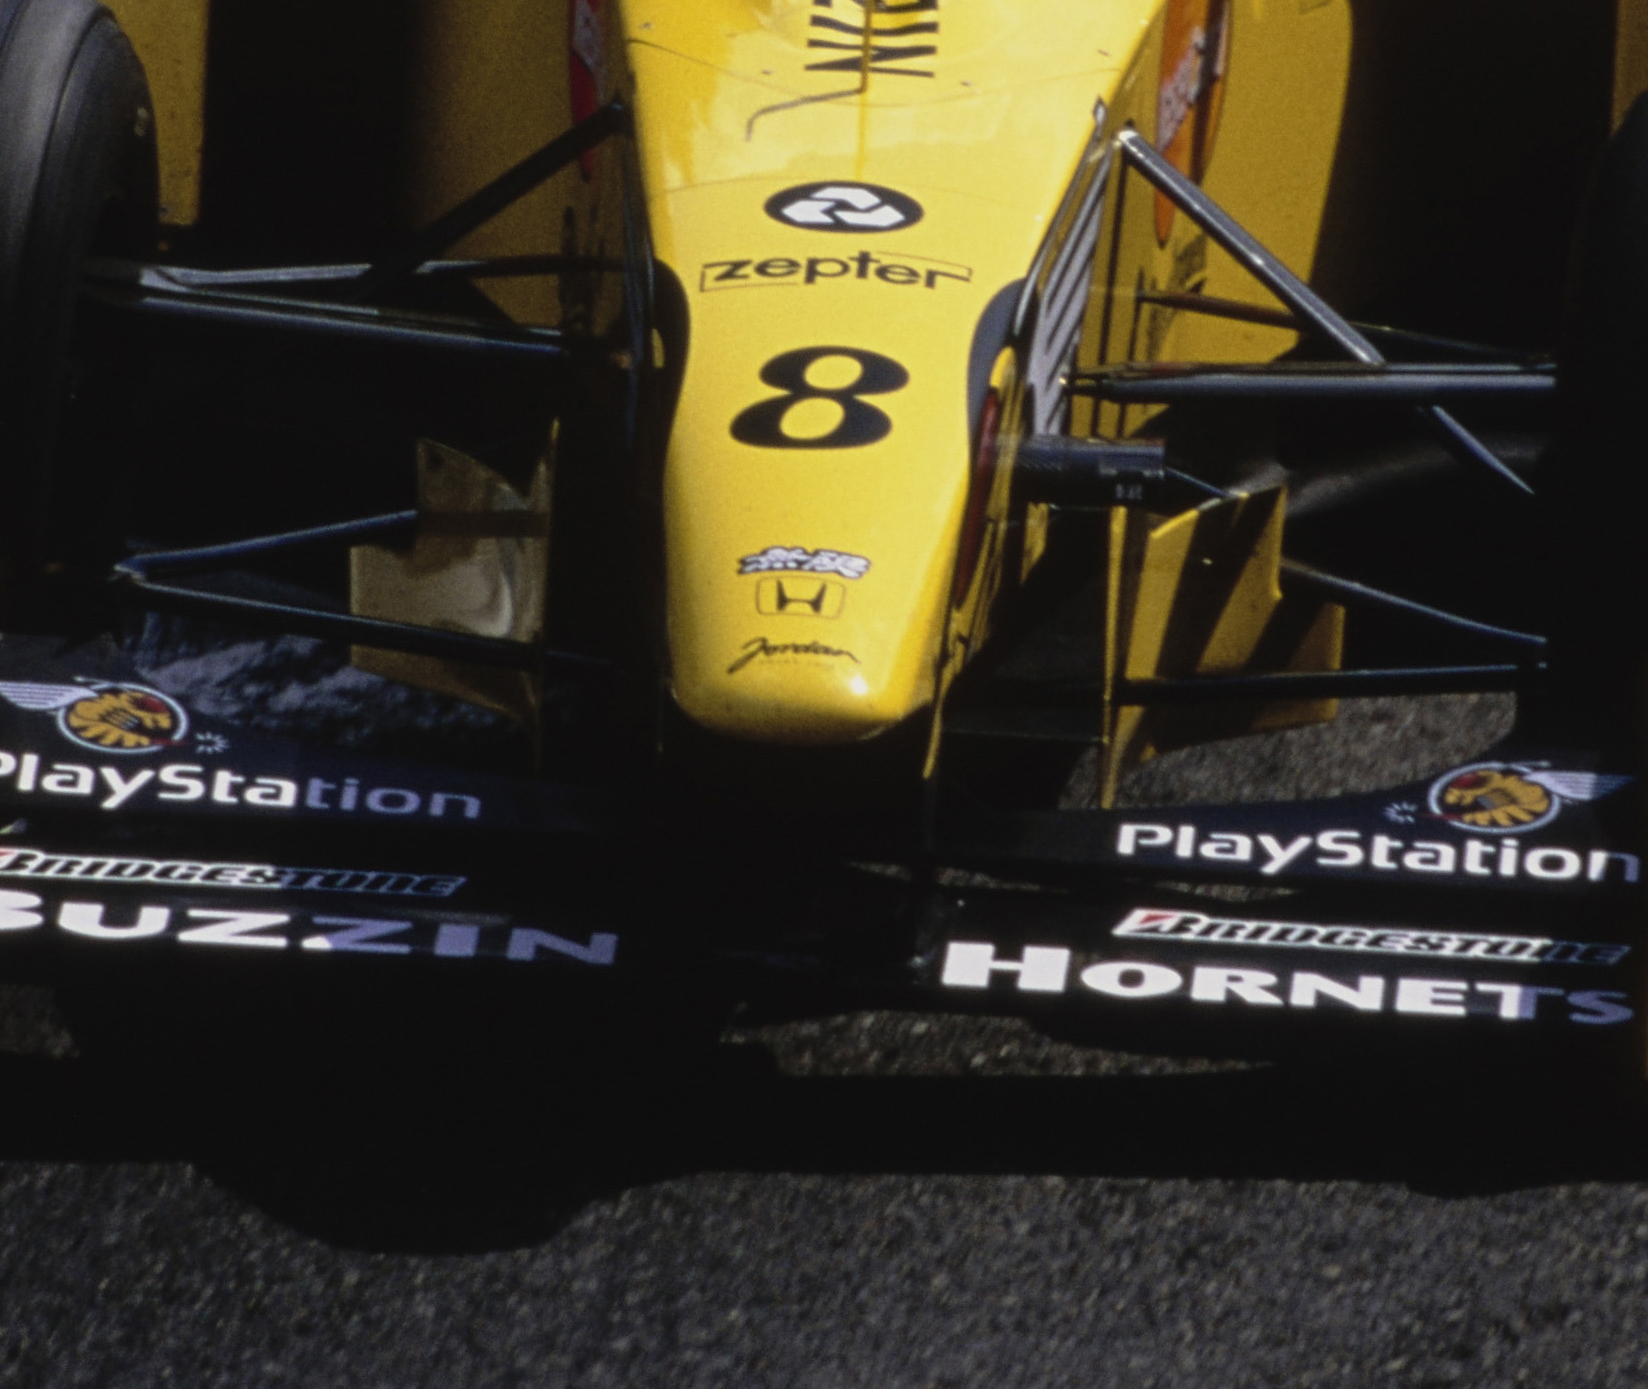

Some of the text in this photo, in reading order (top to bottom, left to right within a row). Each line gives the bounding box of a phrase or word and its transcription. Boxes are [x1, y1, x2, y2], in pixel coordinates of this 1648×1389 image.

[701, 250, 972, 290] zepter
[729, 345, 910, 450] 8
[1115, 822, 1640, 882] PlayStation
[1113, 908, 1631, 965] BRIDGESTONE
[941, 941, 1636, 1025] HORNETS
